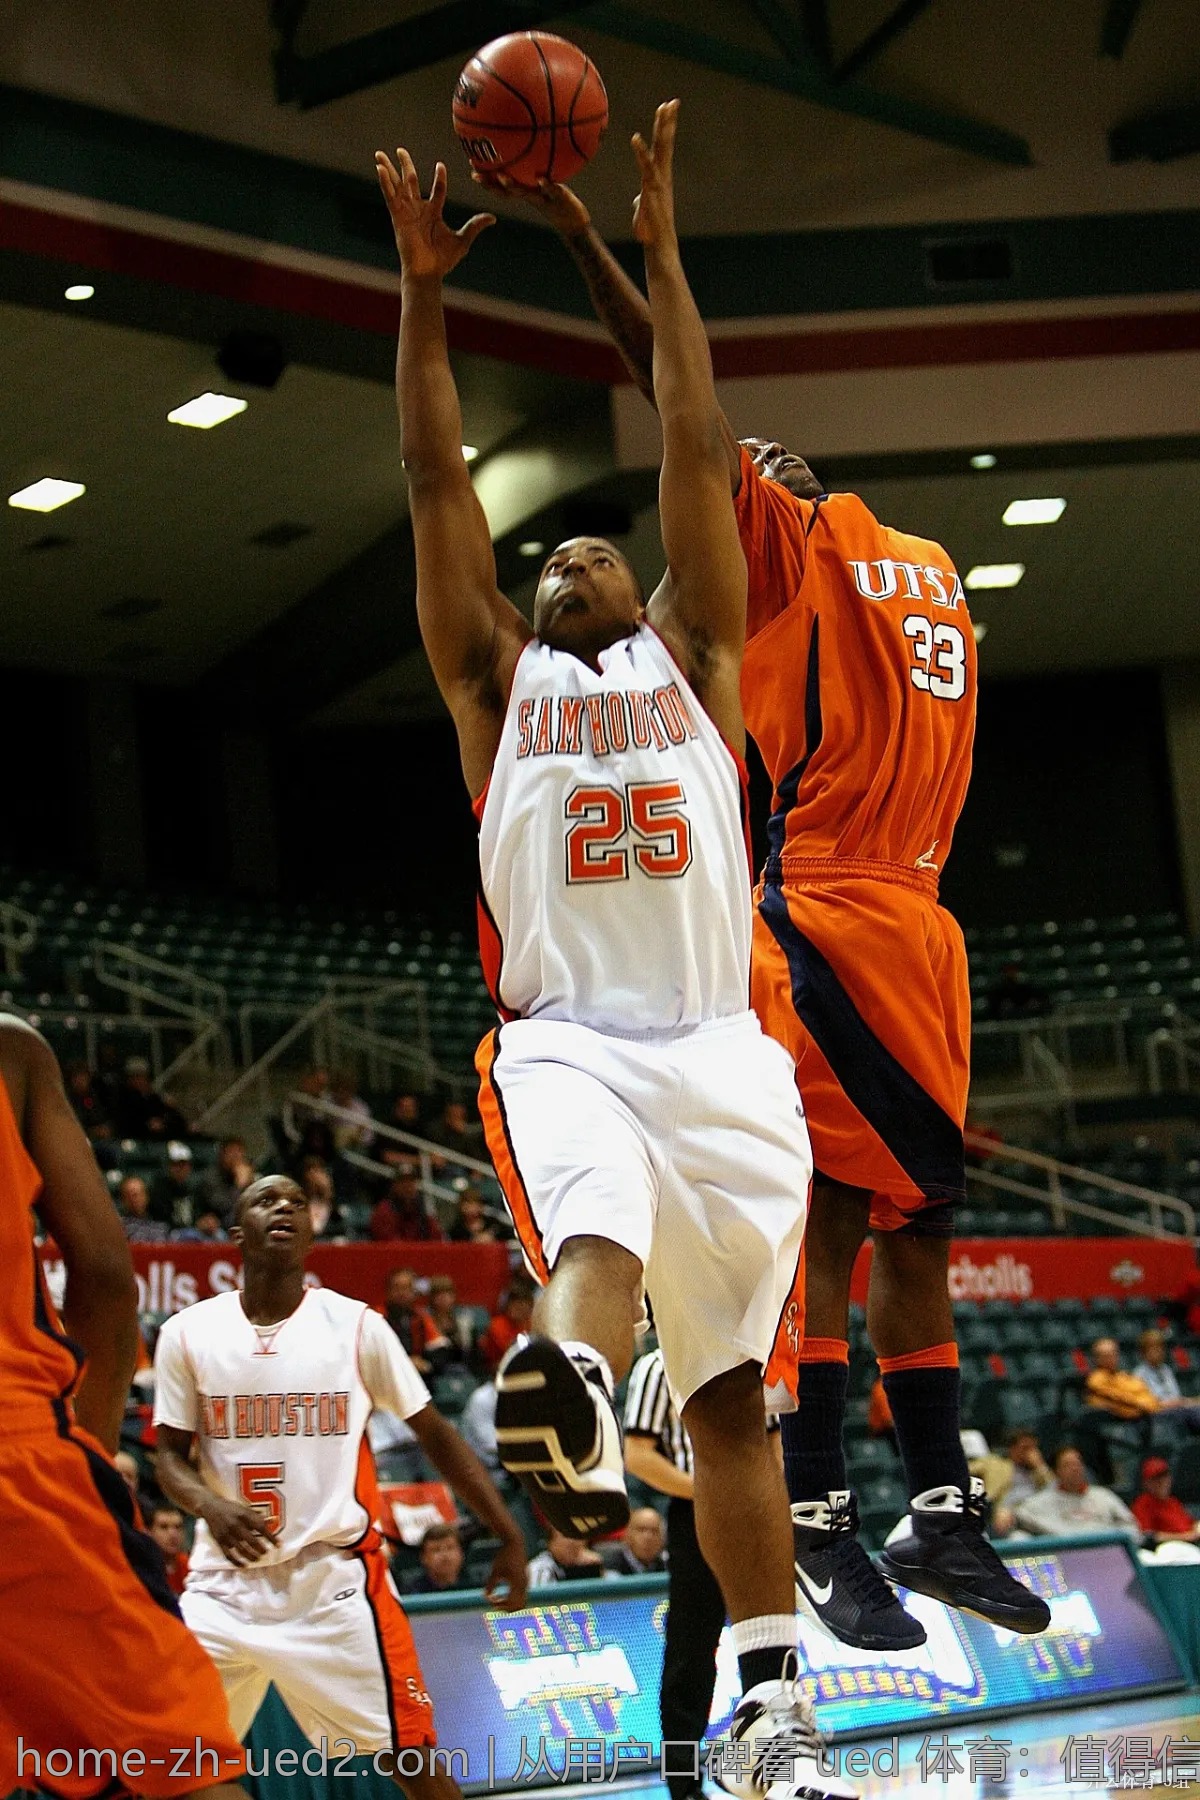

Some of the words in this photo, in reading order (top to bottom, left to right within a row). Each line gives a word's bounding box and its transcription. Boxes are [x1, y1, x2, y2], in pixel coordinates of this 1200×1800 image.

[847, 558, 968, 611] UTSA
[902, 614, 967, 702] 33
[516, 696, 585, 760] SAM
[565, 778, 693, 886] 25
[237, 1461, 286, 1537] 5
